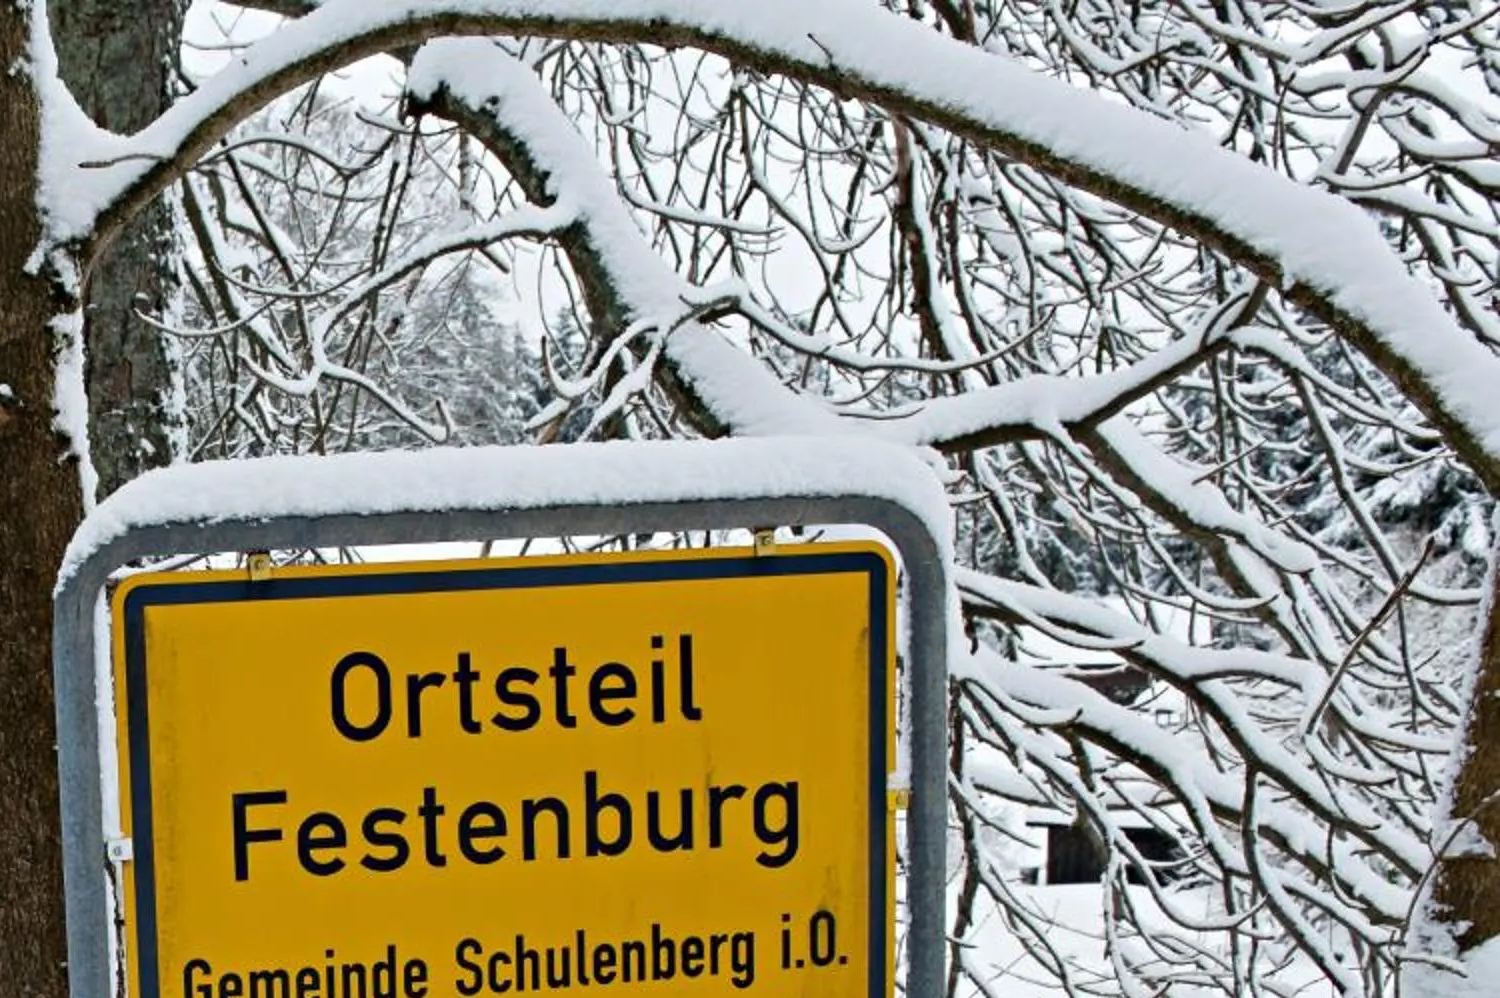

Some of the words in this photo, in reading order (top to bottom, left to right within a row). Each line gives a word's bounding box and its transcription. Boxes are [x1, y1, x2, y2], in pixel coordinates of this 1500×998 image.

[330, 633, 703, 742] Ortsteil
[231, 770, 800, 882] Festenburg
[454, 923, 756, 997] Schulenberg
[780, 908, 850, 971] i.O.
